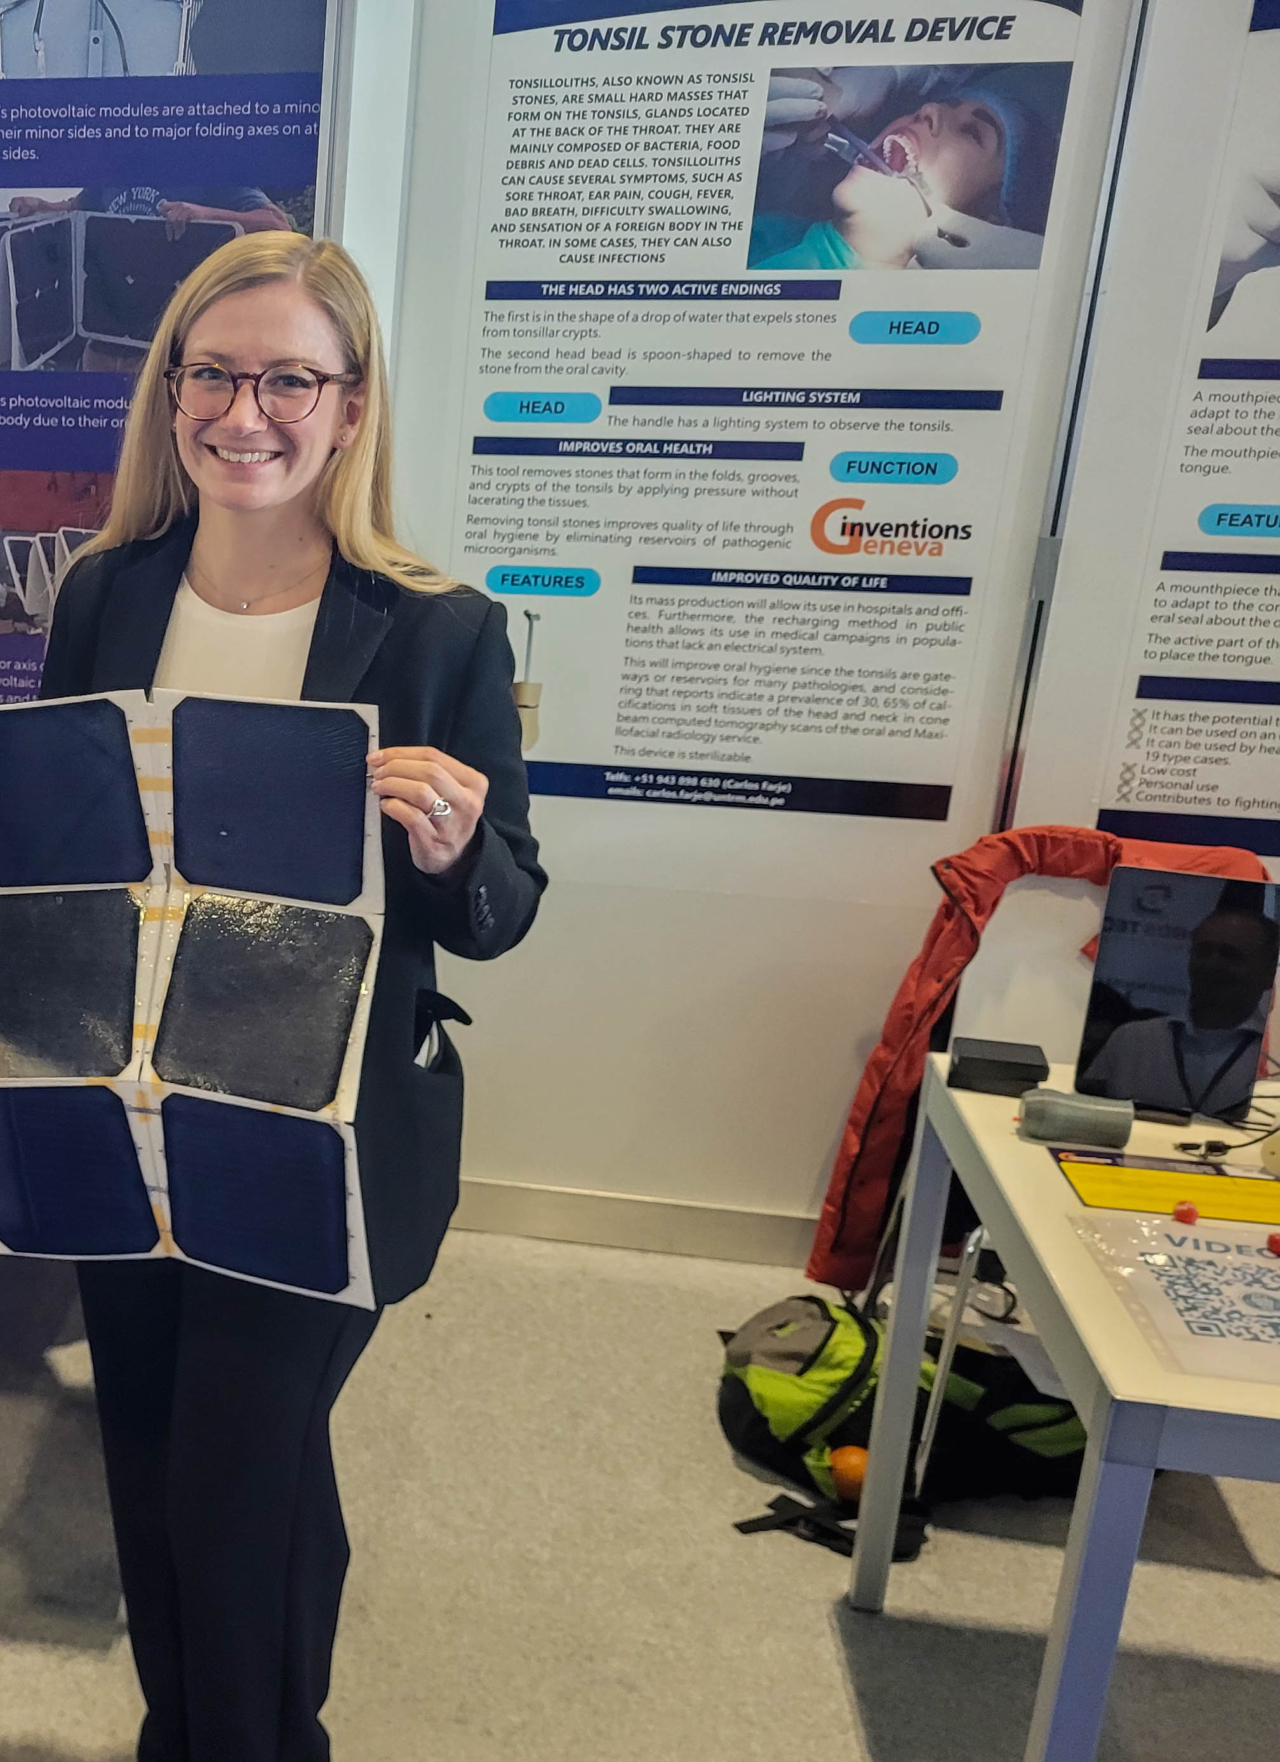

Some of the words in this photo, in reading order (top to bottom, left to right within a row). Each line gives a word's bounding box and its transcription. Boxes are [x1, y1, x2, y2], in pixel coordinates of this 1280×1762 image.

[553, 25, 650, 53] TONSIL
[656, 22, 755, 50] STONE
[757, 18, 897, 47] REMOVAL
[903, 14, 1017, 43] DEVICE
[508, 76, 599, 90] TONSILLOLITHS,
[601, 75, 633, 87] ALSO
[635, 74, 685, 87] KNOWN
[686, 73, 703, 85] AS
[706, 72, 755, 85] TONSISL
[10, 103, 96, 123] photovoltaic
[99, 102, 160, 118] modules
[161, 105, 185, 117] are
[187, 100, 251, 116] attached
[254, 101, 270, 115] to
[272, 103, 281, 115] a
[284, 99, 321, 116] mino
[25, 125, 65, 140] minor
[67, 124, 102, 139] sides
[104, 123, 131, 139] and
[134, 124, 149, 138] to
[152, 126, 193, 141] major
[195, 122, 244, 141] folding
[247, 125, 280, 136] axes
[282, 124, 301, 136] on
[304, 121, 319, 136] at
[2, 146, 40, 162] sides.
[131, 187, 160, 204] YORK
[558, 253, 596, 264] CAUSE
[597, 252, 666, 264] INFECTIONS
[540, 283, 567, 296] THE
[568, 283, 605, 296] HEAD
[607, 283, 635, 296] HAS
[637, 283, 670, 296] TWO
[671, 283, 719, 296] ACTIVE
[720, 283, 782, 296] ENDINGS
[481, 325, 511, 339] from
[512, 326, 561, 339] tonsillar
[561, 327, 599, 342] crypts.
[888, 319, 941, 337] HEAD
[9, 394, 91, 410] photovoltaic
[93, 395, 132, 411] modu
[742, 390, 806, 404] LIGHTING
[807, 391, 862, 404] SYSTEM
[518, 399, 566, 416] HEAD
[32, 413, 59, 427] due
[61, 415, 76, 427] to
[78, 415, 108, 428] their
[606, 415, 629, 427] The
[632, 415, 674, 428] handle
[677, 415, 699, 428] has
[701, 418, 710, 429] a
[713, 416, 761, 433] lighting
[764, 419, 809, 433] system
[812, 418, 826, 431] to
[829, 418, 881, 432] observe
[884, 418, 906, 432] the
[908, 419, 955, 433] tonsils.
[558, 440, 624, 454] IMPROVES
[625, 441, 661, 454] ORAL
[662, 442, 714, 455] HEALTH
[845, 460, 939, 477] FUNCTION
[810, 497, 944, 558] Geneva
[840, 515, 973, 541] inventions
[1216, 512, 1280, 529] FEATU
[500, 573, 586, 590] FEATURES
[710, 571, 781, 585] IMPROVED
[782, 573, 840, 587] QUALITY
[840, 575, 860, 588] OF
[860, 576, 889, 589] LIFE
[13, 661, 38, 672] axis
[1140, 764, 1166, 776] Low
[1169, 767, 1198, 778] cost
[1138, 778, 1194, 791] Personal
[1196, 782, 1220, 793] use
[1163, 1232, 1280, 1260] VIDEO
